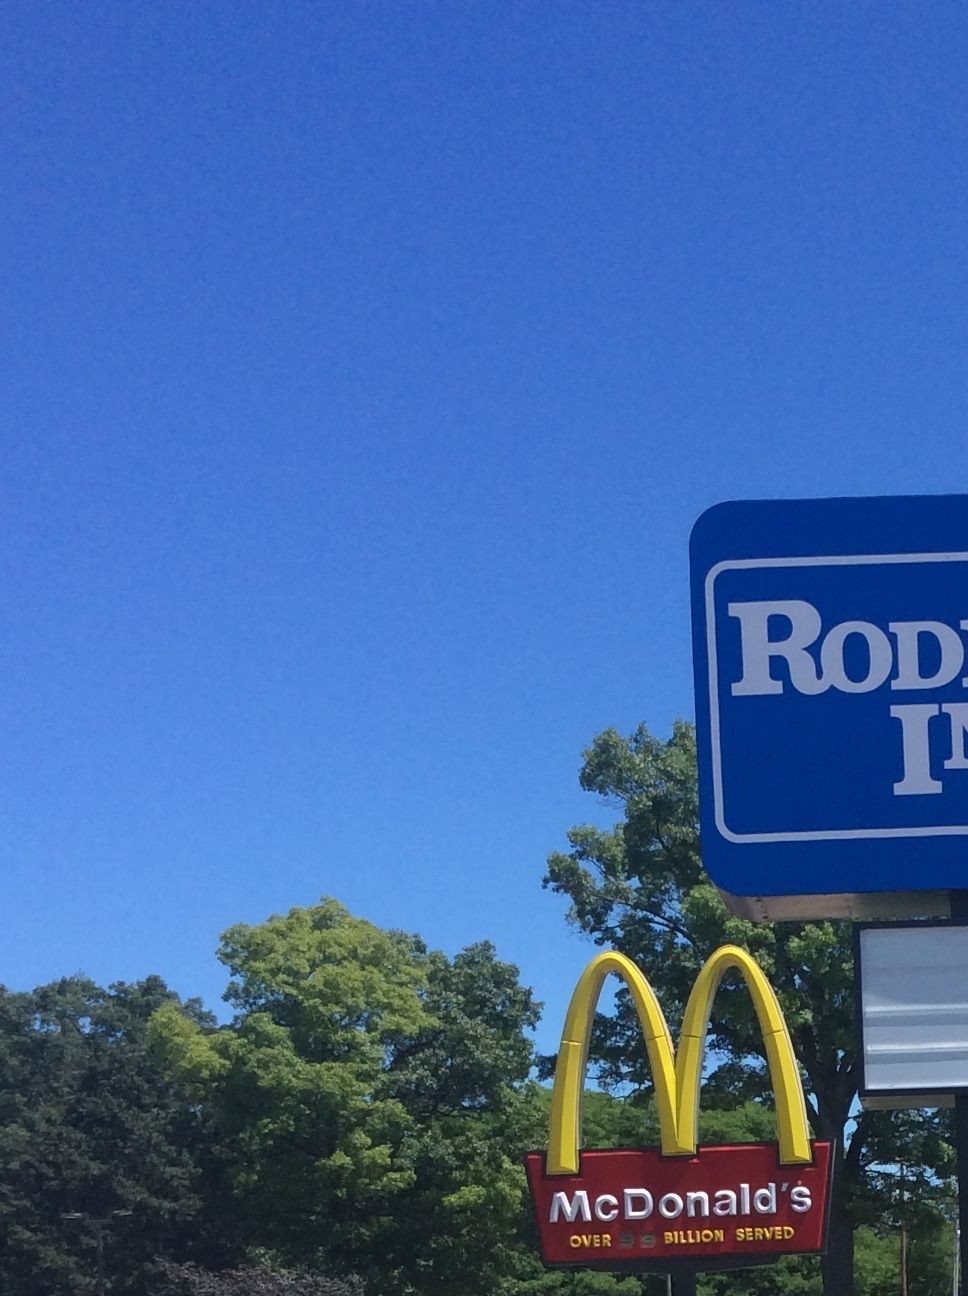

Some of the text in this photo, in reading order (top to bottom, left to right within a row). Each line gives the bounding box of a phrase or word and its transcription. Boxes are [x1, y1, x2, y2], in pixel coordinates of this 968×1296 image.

[549, 1182, 813, 1223] McDonald's
[569, 1233, 612, 1248] OVER
[663, 1229, 725, 1245] BILLION
[735, 1226, 796, 1242] SERVED
